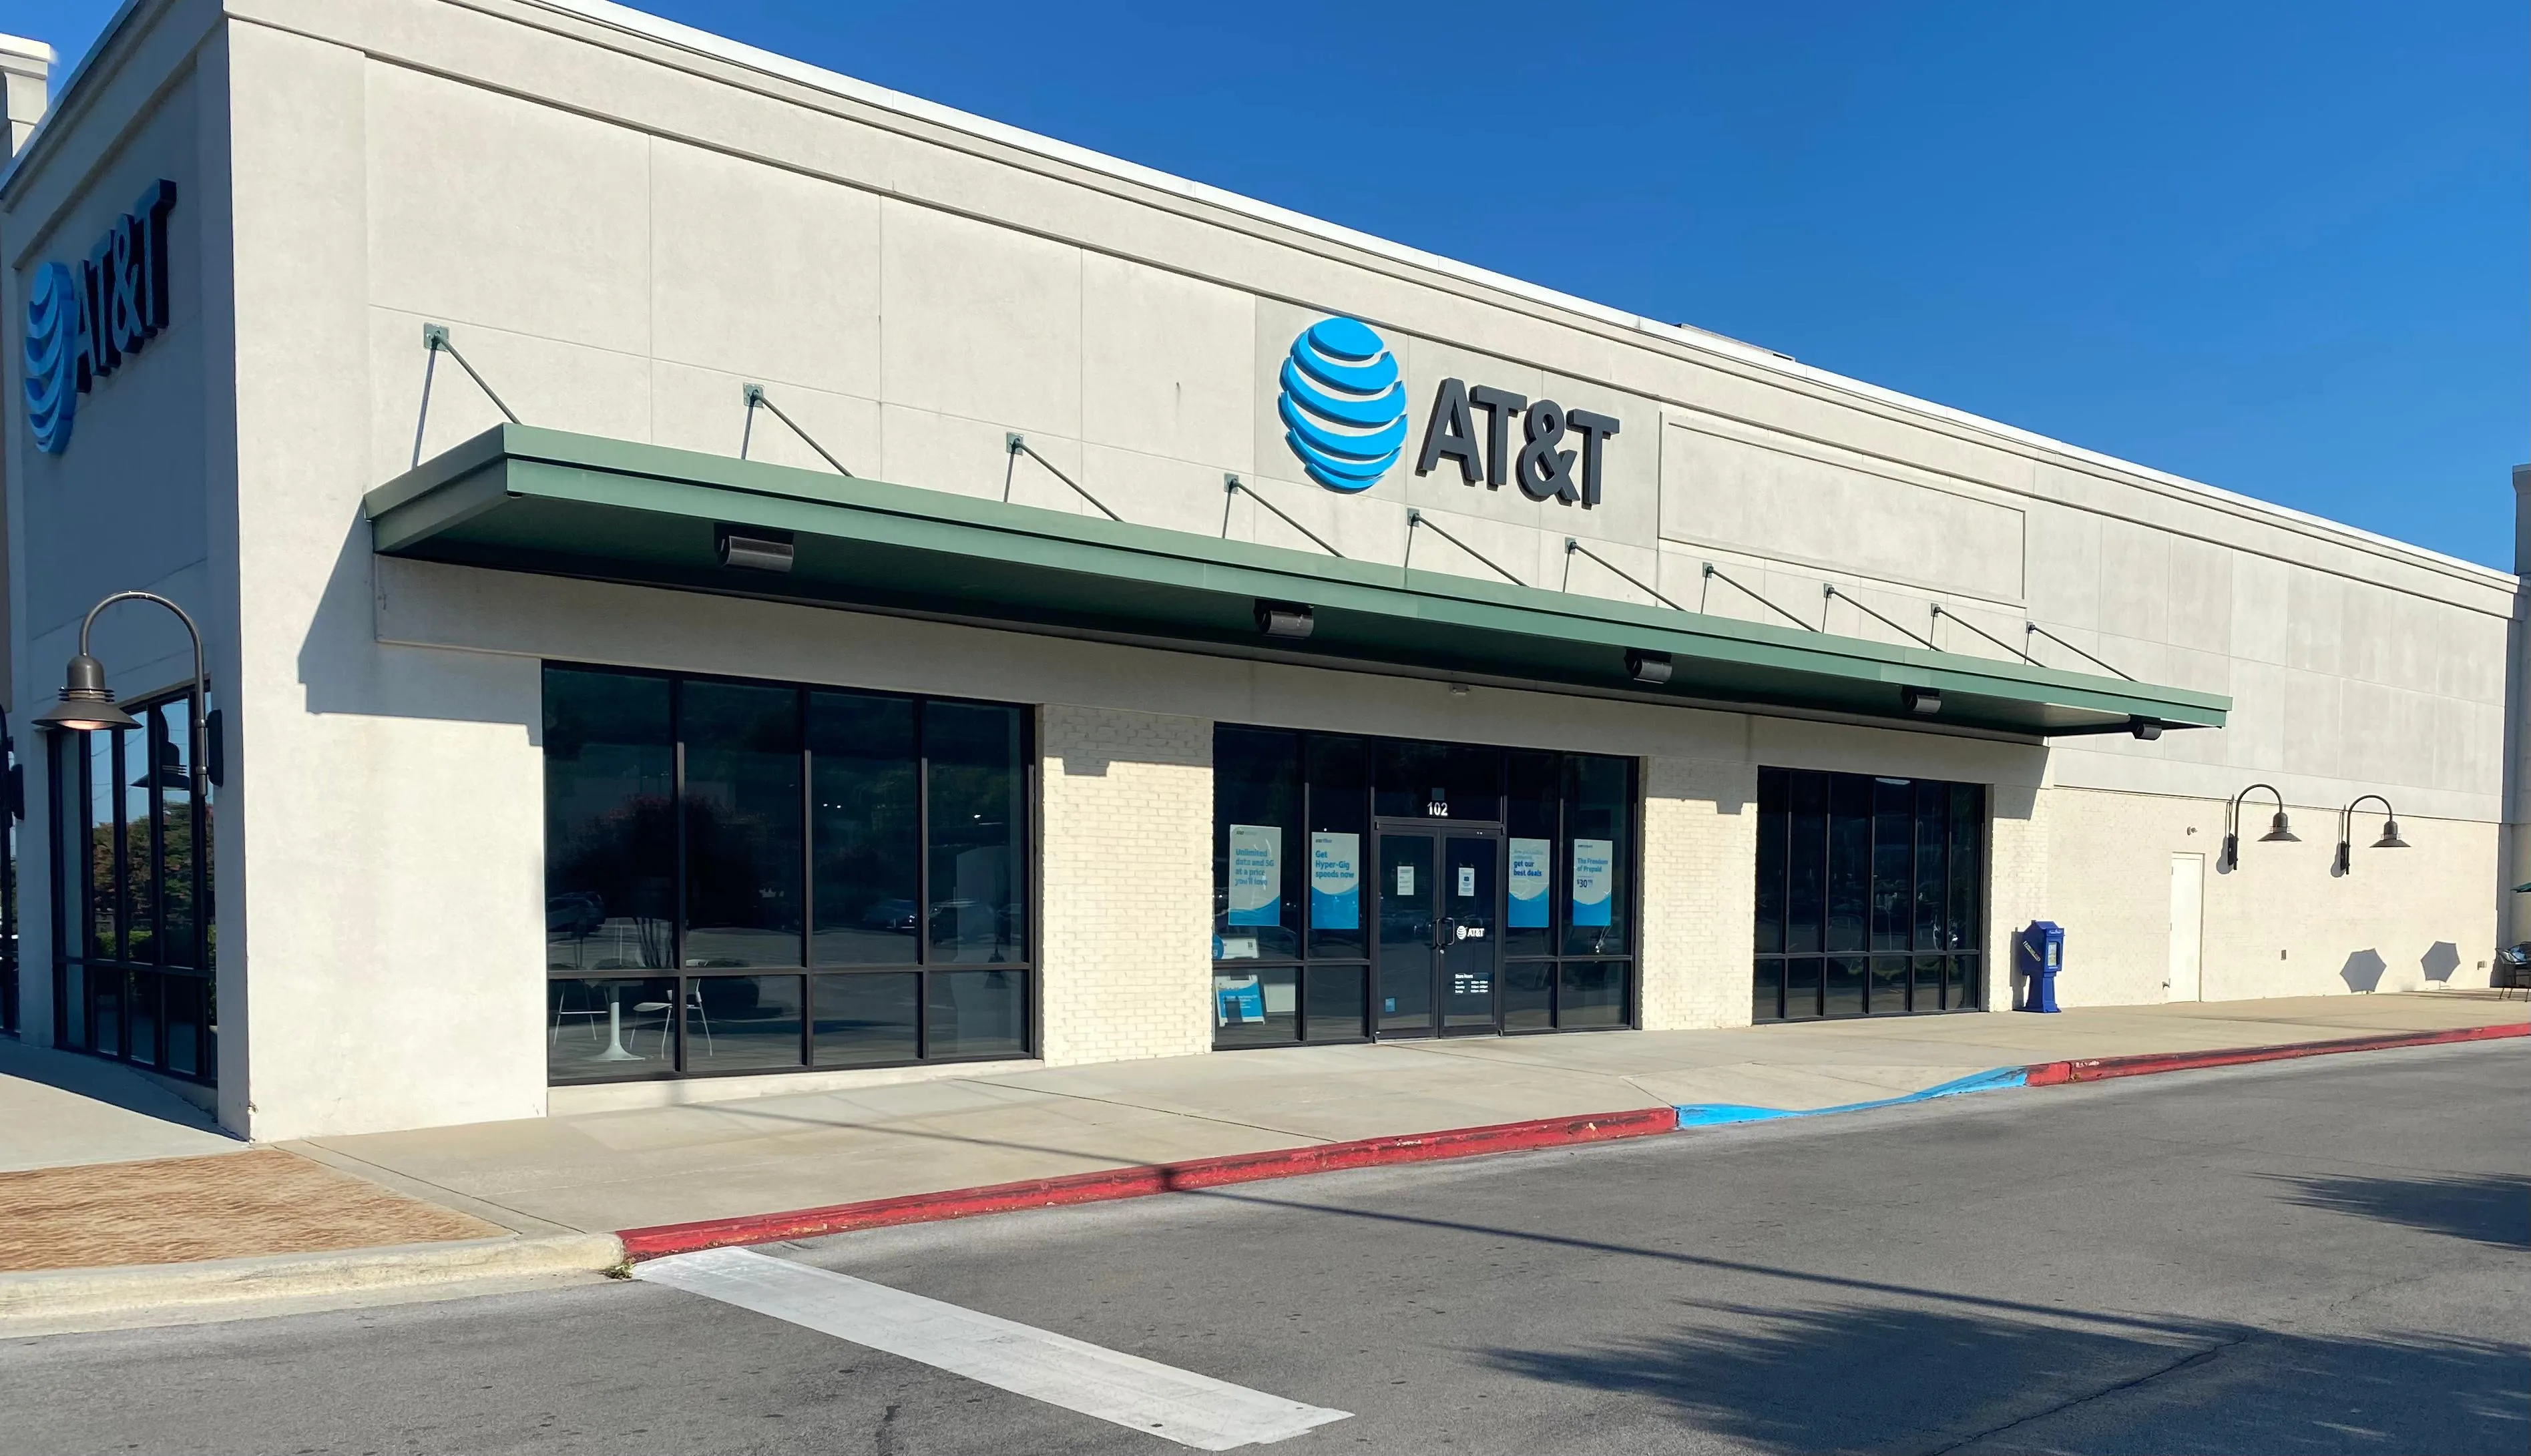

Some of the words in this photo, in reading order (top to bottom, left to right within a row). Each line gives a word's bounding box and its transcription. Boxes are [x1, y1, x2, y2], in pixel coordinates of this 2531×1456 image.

[75, 179, 177, 393] AT&T
[1415, 377, 1620, 509] AT&T
[1427, 801, 1448, 816] 102
[1235, 848, 1268, 857] Unlimited
[1315, 851, 1328, 859] Get
[1235, 858, 1251, 866] data
[1252, 859, 1264, 867] and
[1315, 860, 1350, 871] Hyper-Gig
[1514, 861, 1523, 869] get
[1248, 869, 1265, 877] price
[1315, 870, 1339, 879] speeds
[1513, 869, 1526, 877] best
[1467, 928, 1485, 937] AT&T
